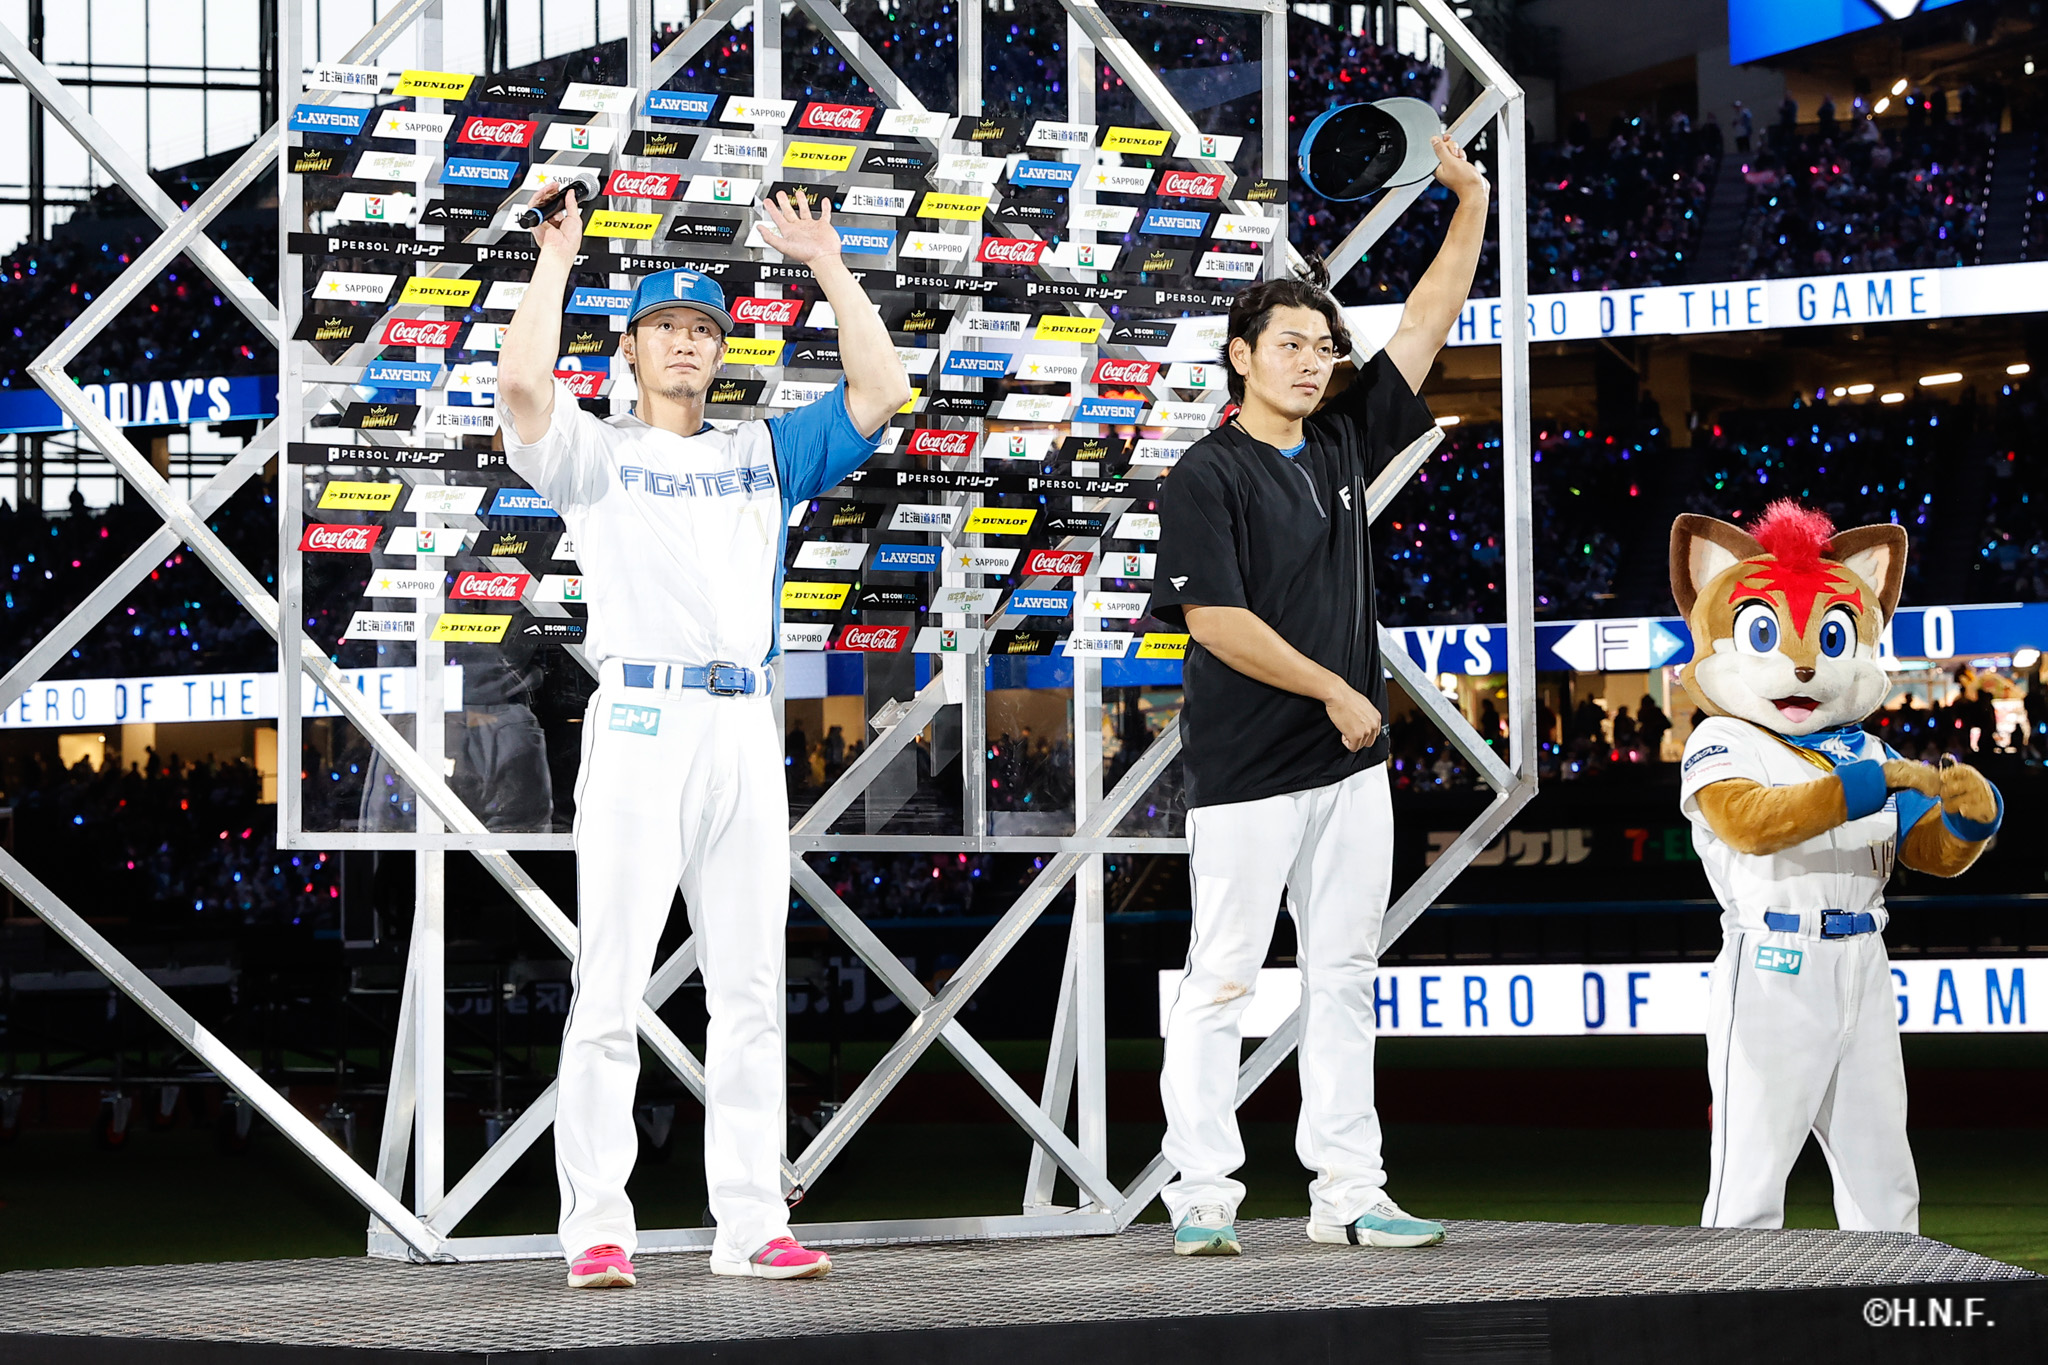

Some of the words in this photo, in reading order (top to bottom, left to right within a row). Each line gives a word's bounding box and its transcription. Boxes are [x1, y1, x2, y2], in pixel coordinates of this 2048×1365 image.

[413, 79, 465, 92] DUNLOP
[650, 98, 708, 112] LAWSON
[298, 111, 360, 127] LAWSON
[750, 108, 786, 118] SAPPORO
[809, 107, 863, 128] Coca-Cola
[405, 122, 443, 134] SAPPORO
[468, 119, 526, 144] Coca-Cola
[1118, 137, 1163, 147] DUNLOP
[800, 152, 847, 162] DUNLOP
[449, 164, 509, 180] LAWSON
[1019, 167, 1073, 182] LAWSON
[552, 175, 574, 184] SAPP
[613, 173, 669, 197] Coca-Cola
[1111, 176, 1145, 186] SAPPORO
[1165, 173, 1217, 196] Coca-Cola
[936, 202, 981, 213] DUNLOP
[605, 220, 652, 231] DUNLOP
[1149, 215, 1201, 229] LAWSON
[1238, 225, 1271, 234] SAPPORO
[342, 240, 390, 252] PERSOL
[842, 235, 888, 248] AWSON
[928, 243, 962, 253] SAPPORO
[490, 250, 536, 261] PERSOL
[984, 239, 1038, 262] Coca-Cola
[633, 260, 677, 269] PERSOL
[345, 283, 384, 294] SAPPORO
[674, 271, 699, 300] F
[907, 277, 949, 287] PERSOL
[419, 287, 470, 298] DUNLOP
[1038, 285, 1080, 295] PERSOL
[1166, 293, 1206, 304] PERSOL
[1211, 296, 1234, 306] パ・リ
[1600, 294, 1645, 333] OF
[1679, 287, 1762, 327] THE
[1799, 276, 1926, 321] GAME
[736, 300, 792, 322] Coca-Cola
[390, 322, 449, 346] Coca-Cola
[1051, 325, 1096, 335] DUNLOP
[728, 347, 775, 357] DUNLOP
[950, 358, 1004, 371] LAWSON
[1044, 365, 1078, 375] SAPPORO
[370, 368, 431, 382] LAWSON
[1099, 361, 1151, 384] Coca-Cola
[476, 376, 497, 385] SAPP
[1083, 405, 1135, 418] LAWSON
[1173, 412, 1206, 422] SAPPORO
[915, 432, 968, 453] Coca-Cola
[342, 450, 389, 460] PERSOL
[620, 464, 775, 497] FIGHTERS
[908, 474, 950, 484] PERSOL
[1039, 480, 1081, 490] PERSOL
[339, 492, 391, 501] DUNLOP
[981, 517, 1028, 527] DUNLOP
[308, 527, 369, 550] Coca-Cola
[881, 551, 936, 565] LAWSON
[975, 557, 1009, 568] SAPPORO
[1031, 552, 1084, 574] Coca-Cola
[396, 581, 435, 590] SAPPORO
[459, 575, 518, 597] Coca-Cola
[794, 591, 842, 602] DUNLOP
[1014, 596, 1068, 610] LAWSON
[1106, 602, 1140, 611] SAPPORO
[450, 624, 501, 633] DUNLOP
[787, 633, 822, 644] SAPPORO
[845, 627, 899, 650] Coca-Cola
[1, 687, 86, 722] ERO
[115, 683, 154, 720] OF
[183, 680, 254, 717] THE
[612, 707, 658, 730] ニトリ
[1758, 950, 1799, 971] ニトリ
[1374, 975, 1533, 1028] HERO
[1583, 972, 1651, 1028] OF
[1891, 968, 2026, 1025] GAM
